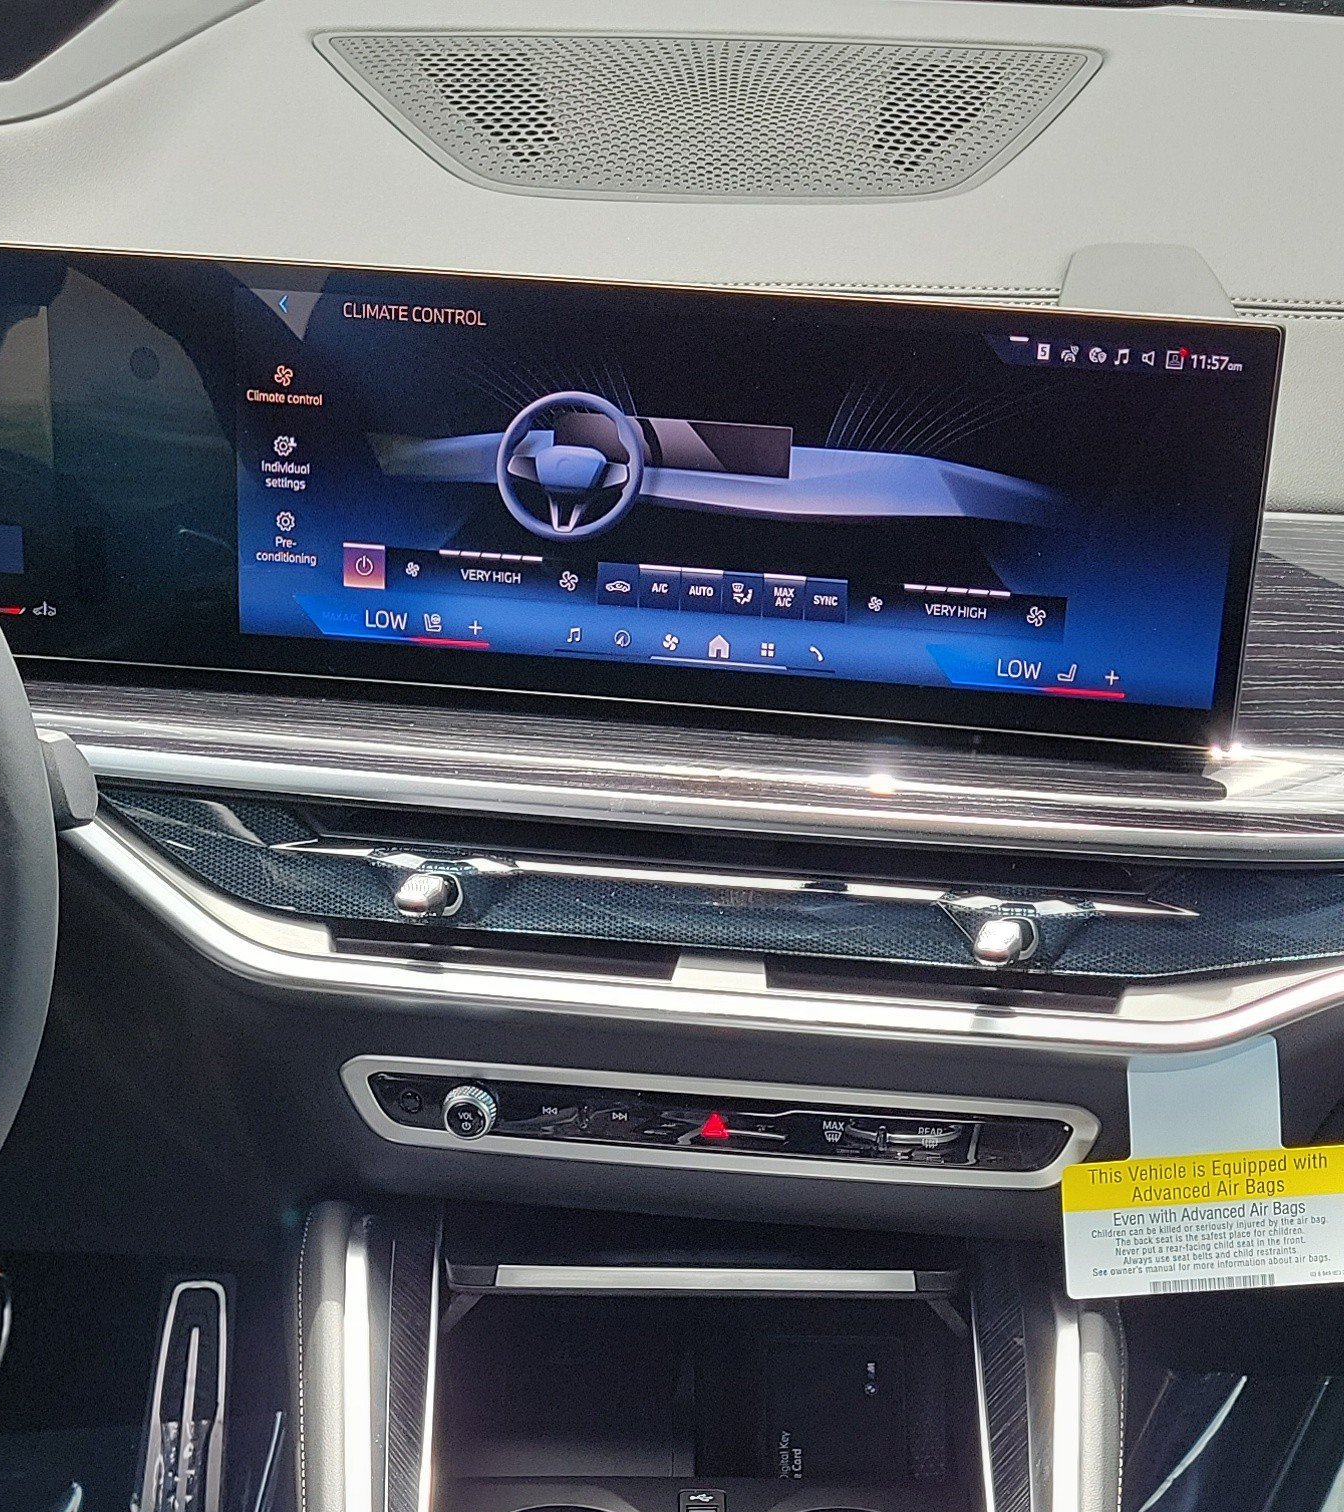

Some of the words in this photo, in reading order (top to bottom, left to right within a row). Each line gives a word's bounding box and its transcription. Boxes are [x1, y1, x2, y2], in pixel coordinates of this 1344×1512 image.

[343, 302, 408, 322] CLIMATE
[412, 306, 486, 326] CONTROL
[246, 390, 285, 404] Climate
[288, 392, 323, 406] control
[261, 460, 310, 475] Individual
[265, 475, 306, 491] settings
[275, 536, 297, 549] Pre-
[256, 550, 317, 567] conditioning
[460, 568, 491, 583] VERY
[493, 569, 521, 585] HIGH
[651, 583, 668, 594] A/C
[688, 585, 714, 597] AUTO
[773, 586, 795, 598] MAX
[774, 597, 792, 607] A/C
[813, 594, 839, 607] SYNC
[365, 609, 408, 630] LOW
[925, 603, 955, 618] VERY
[957, 605, 987, 620] HIGH
[996, 658, 1042, 680] LOW
[458, 1111, 473, 1121] VOL
[822, 1120, 845, 1131] MAX
[1088, 1168, 1123, 1185] This
[1128, 1163, 1187, 1182] Vehicle
[1192, 1161, 1206, 1178] is
[1212, 1155, 1287, 1178] Equipped
[1293, 1152, 1328, 1170] with
[1132, 1181, 1210, 1202] Advanced
[1216, 1179, 1240, 1197] Air
[1246, 1178, 1285, 1197] Bags
[1113, 1212, 1145, 1227] Even
[1149, 1208, 1177, 1224] with
[1181, 1203, 1245, 1222] Advanced
[1250, 1202, 1269, 1217] Air
[1273, 1201, 1306, 1217] Bags
[1091, 1228, 1126, 1239] Children
[1129, 1227, 1144, 1236] can
[1146, 1225, 1156, 1235] be
[1159, 1223, 1181, 1234] killed
[1184, 1224, 1193, 1233] or
[1195, 1221, 1233, 1233] seriously
[1236, 1218, 1265, 1229] injured
[1268, 1218, 1278, 1229] by
[1281, 1216, 1294, 1226] the
[1297, 1215, 1308, 1225] air
[1115, 1237, 1130, 1247] The
[1134, 1236, 1152, 1246] back
[1156, 1234, 1173, 1244] seat
[1176, 1234, 1183, 1243] is
[1185, 1233, 1198, 1242] the
[1201, 1231, 1226, 1241] safest
[1229, 1228, 1250, 1239] place
[1253, 1227, 1266, 1237] for
[1115, 1246, 1139, 1256] Never
[1142, 1245, 1156, 1256] put
[1166, 1241, 1211, 1254] rear-facing
[1214, 1241, 1234, 1250] child
[1237, 1239, 1254, 1248] seat
[1257, 1237, 1265, 1247] in
[1268, 1236, 1280, 1246] the
[1092, 1267, 1107, 1277] See
[1110, 1265, 1143, 1276] owner's
[1145, 1263, 1176, 1273] manual
[1178, 1261, 1190, 1271] for
[1194, 1260, 1215, 1270] more
[1218, 1257, 1266, 1268] information
[1268, 1255, 1292, 1265] about
[1294, 1254, 1306, 1263] air
[1123, 1255, 1153, 1266] Always
[1155, 1254, 1170, 1263] use
[1173, 1253, 1190, 1262] seat
[1193, 1251, 1213, 1261] belts
[1215, 1250, 1230, 1259] and
[1233, 1248, 1254, 1258] child
[779, 1431, 791, 1449] Key
[792, 1448, 802, 1471] Card
